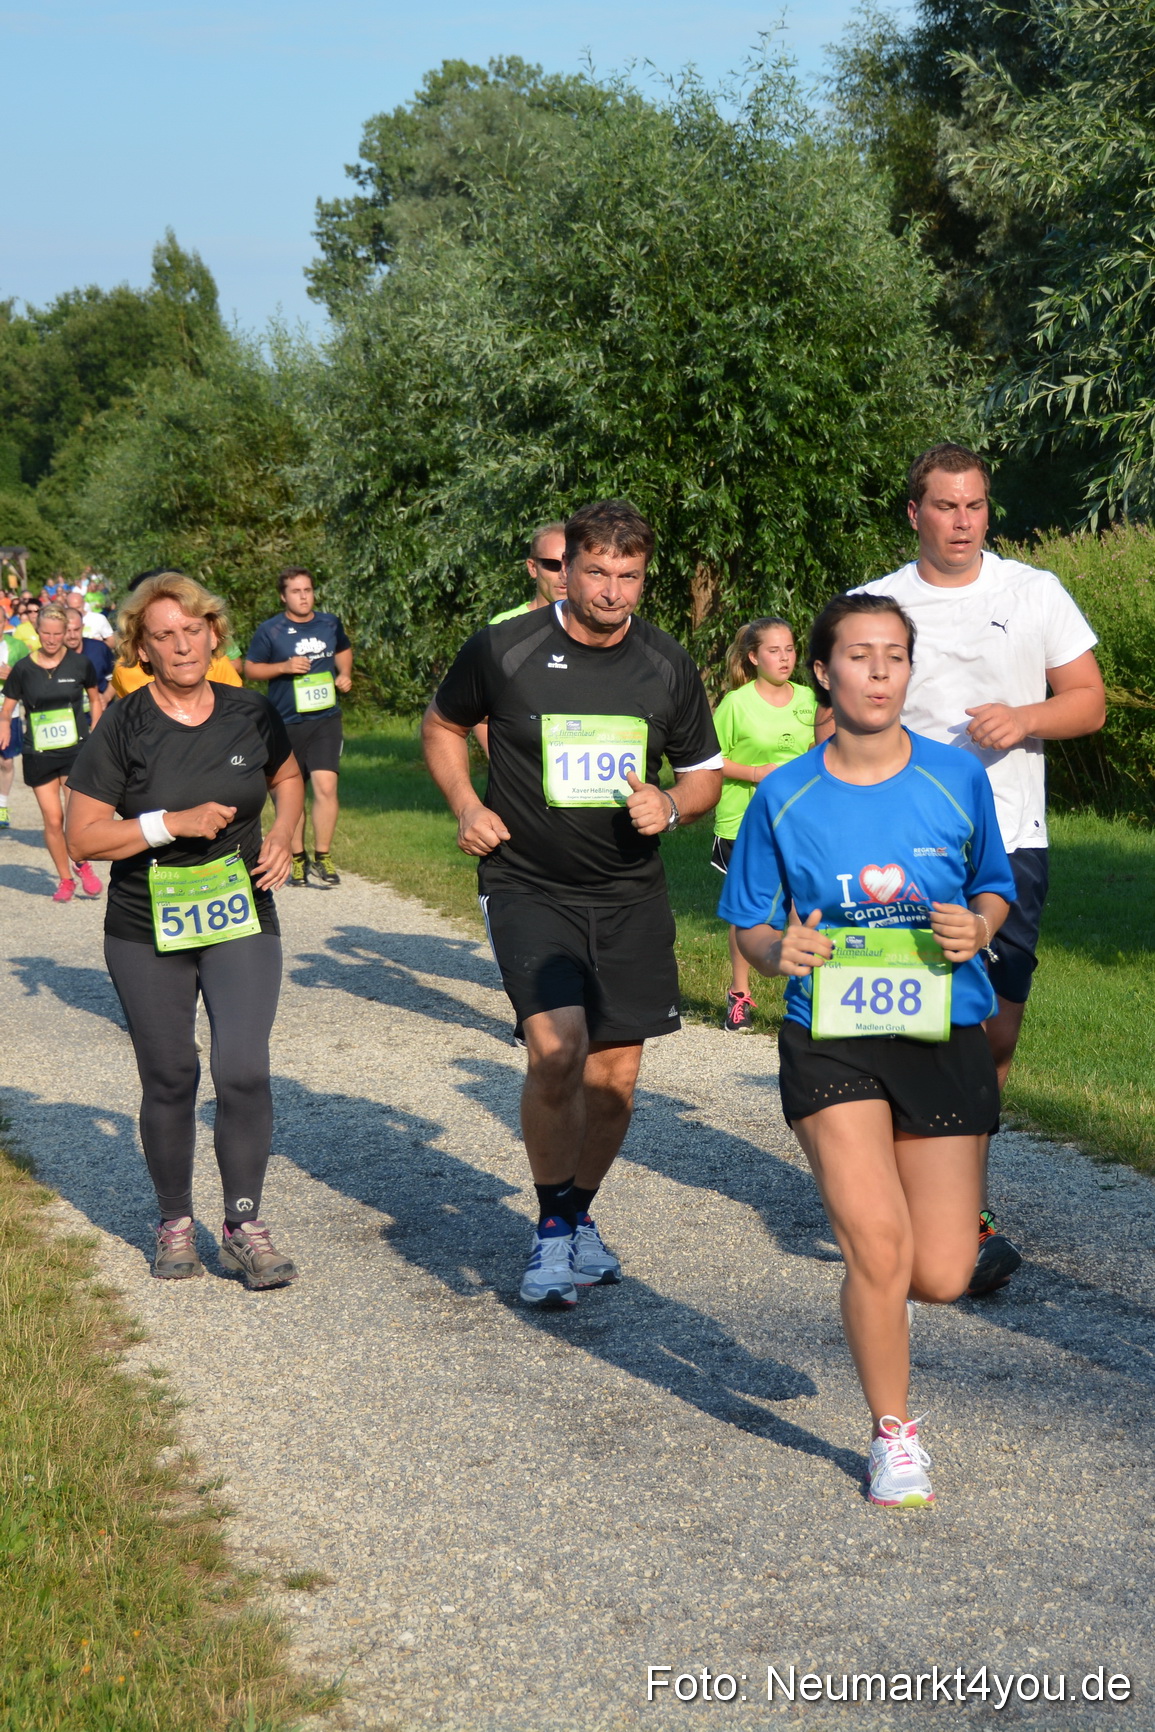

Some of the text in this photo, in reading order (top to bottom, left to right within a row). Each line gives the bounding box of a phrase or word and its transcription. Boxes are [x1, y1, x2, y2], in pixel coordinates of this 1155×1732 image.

[305, 687, 328, 701] 189
[42, 725, 67, 739] 109
[559, 729, 596, 737] firmenlauf
[555, 752, 636, 781] 1196
[153, 870, 180, 880] 2014
[836, 873, 857, 908] I
[161, 893, 250, 937] 5189
[844, 901, 929, 921] camping
[836, 947, 883, 958] firmenlauf
[840, 976, 922, 1016] 488
[855, 1023, 906, 1032] Madlen Groß
